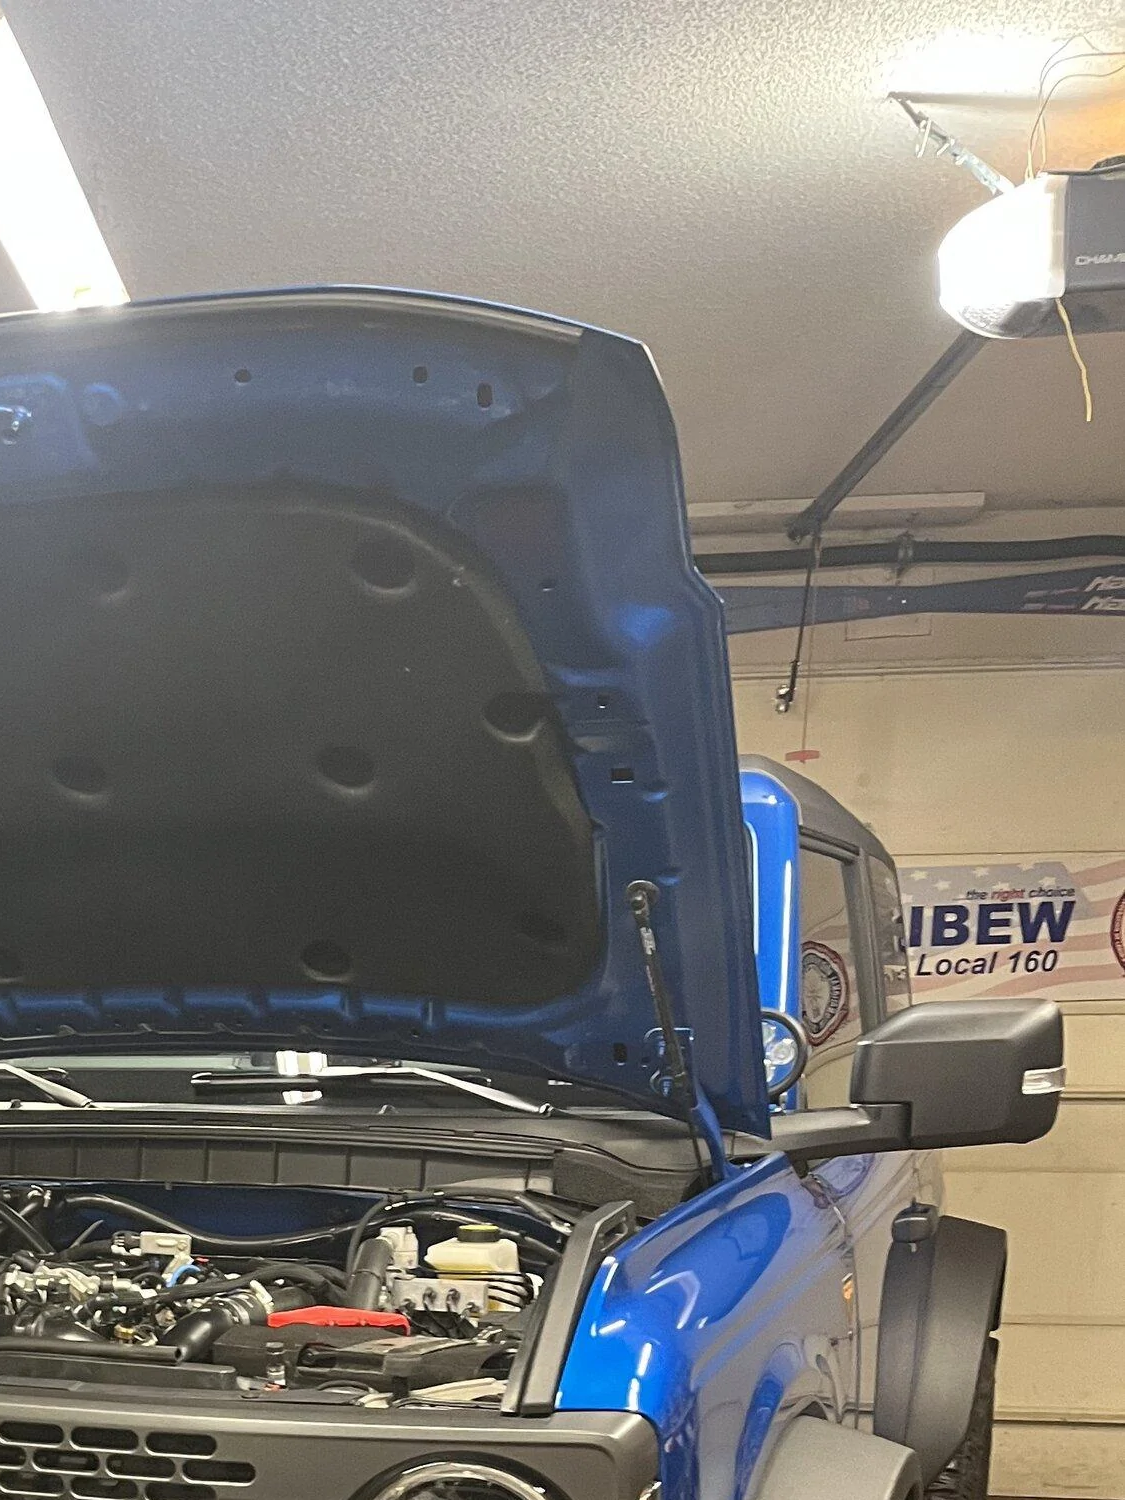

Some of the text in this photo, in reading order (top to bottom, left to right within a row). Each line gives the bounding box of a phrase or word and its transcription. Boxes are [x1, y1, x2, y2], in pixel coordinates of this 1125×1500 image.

[966, 887, 1075, 902] the right choice
[908, 901, 1076, 947] IBEW
[914, 949, 1058, 976] Local 160
